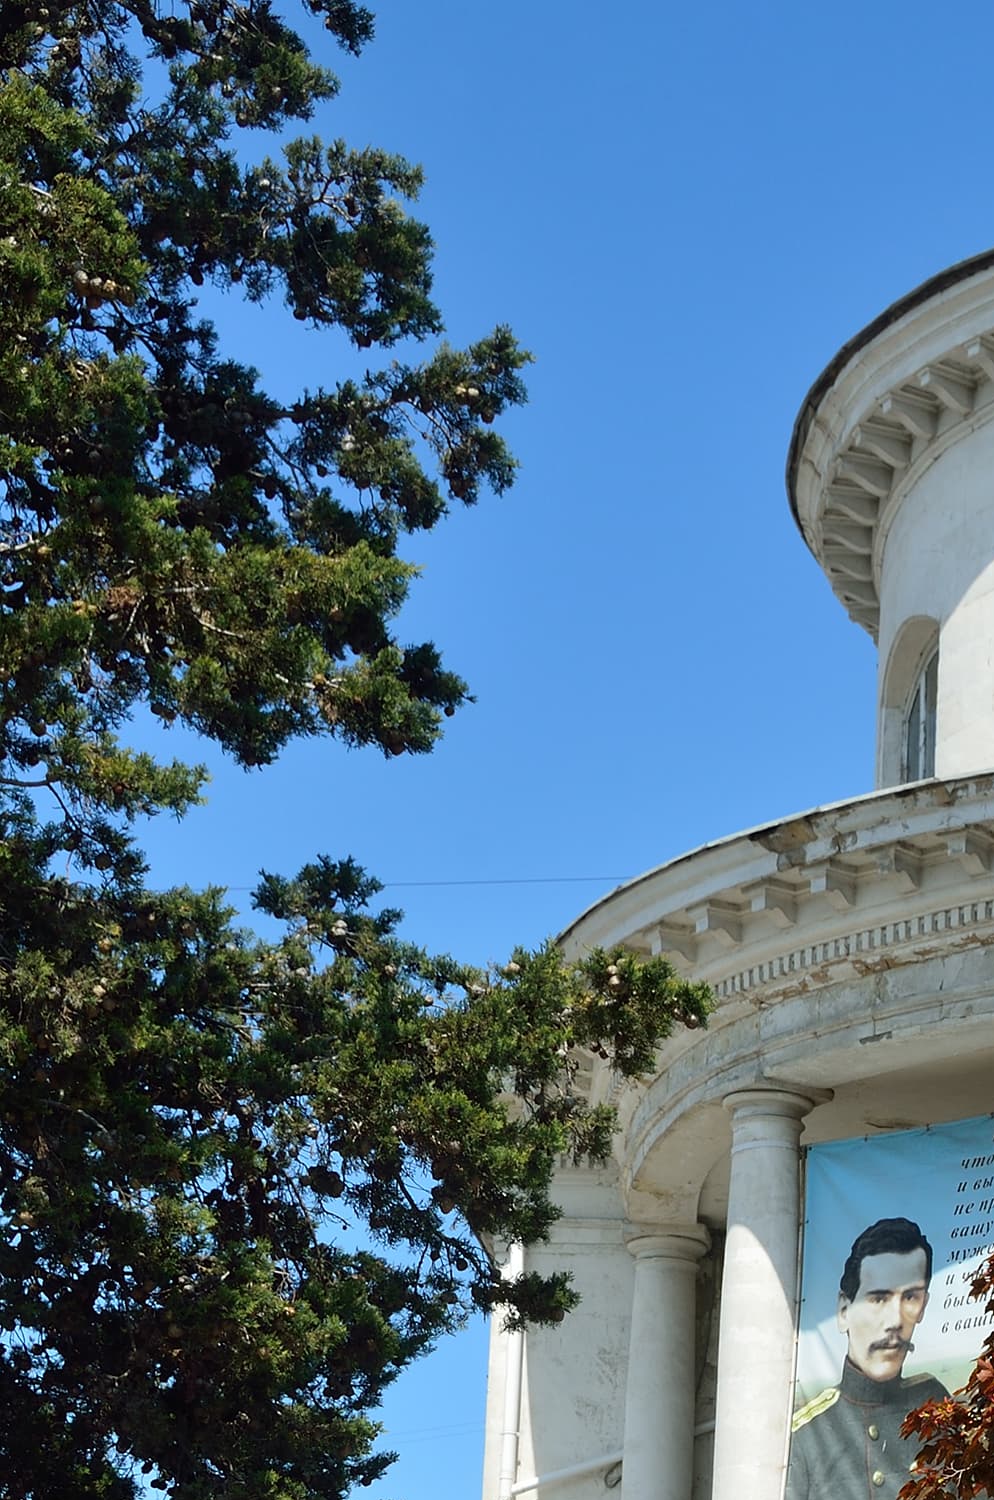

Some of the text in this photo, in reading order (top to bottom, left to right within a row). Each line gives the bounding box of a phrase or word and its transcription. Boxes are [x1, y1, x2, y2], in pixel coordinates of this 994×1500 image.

[957, 1182, 967, 1193] и
[973, 1177, 994, 1190] вы
[953, 1203, 975, 1216] не
[951, 1221, 994, 1239] вашу
[941, 1321, 950, 1334] в
